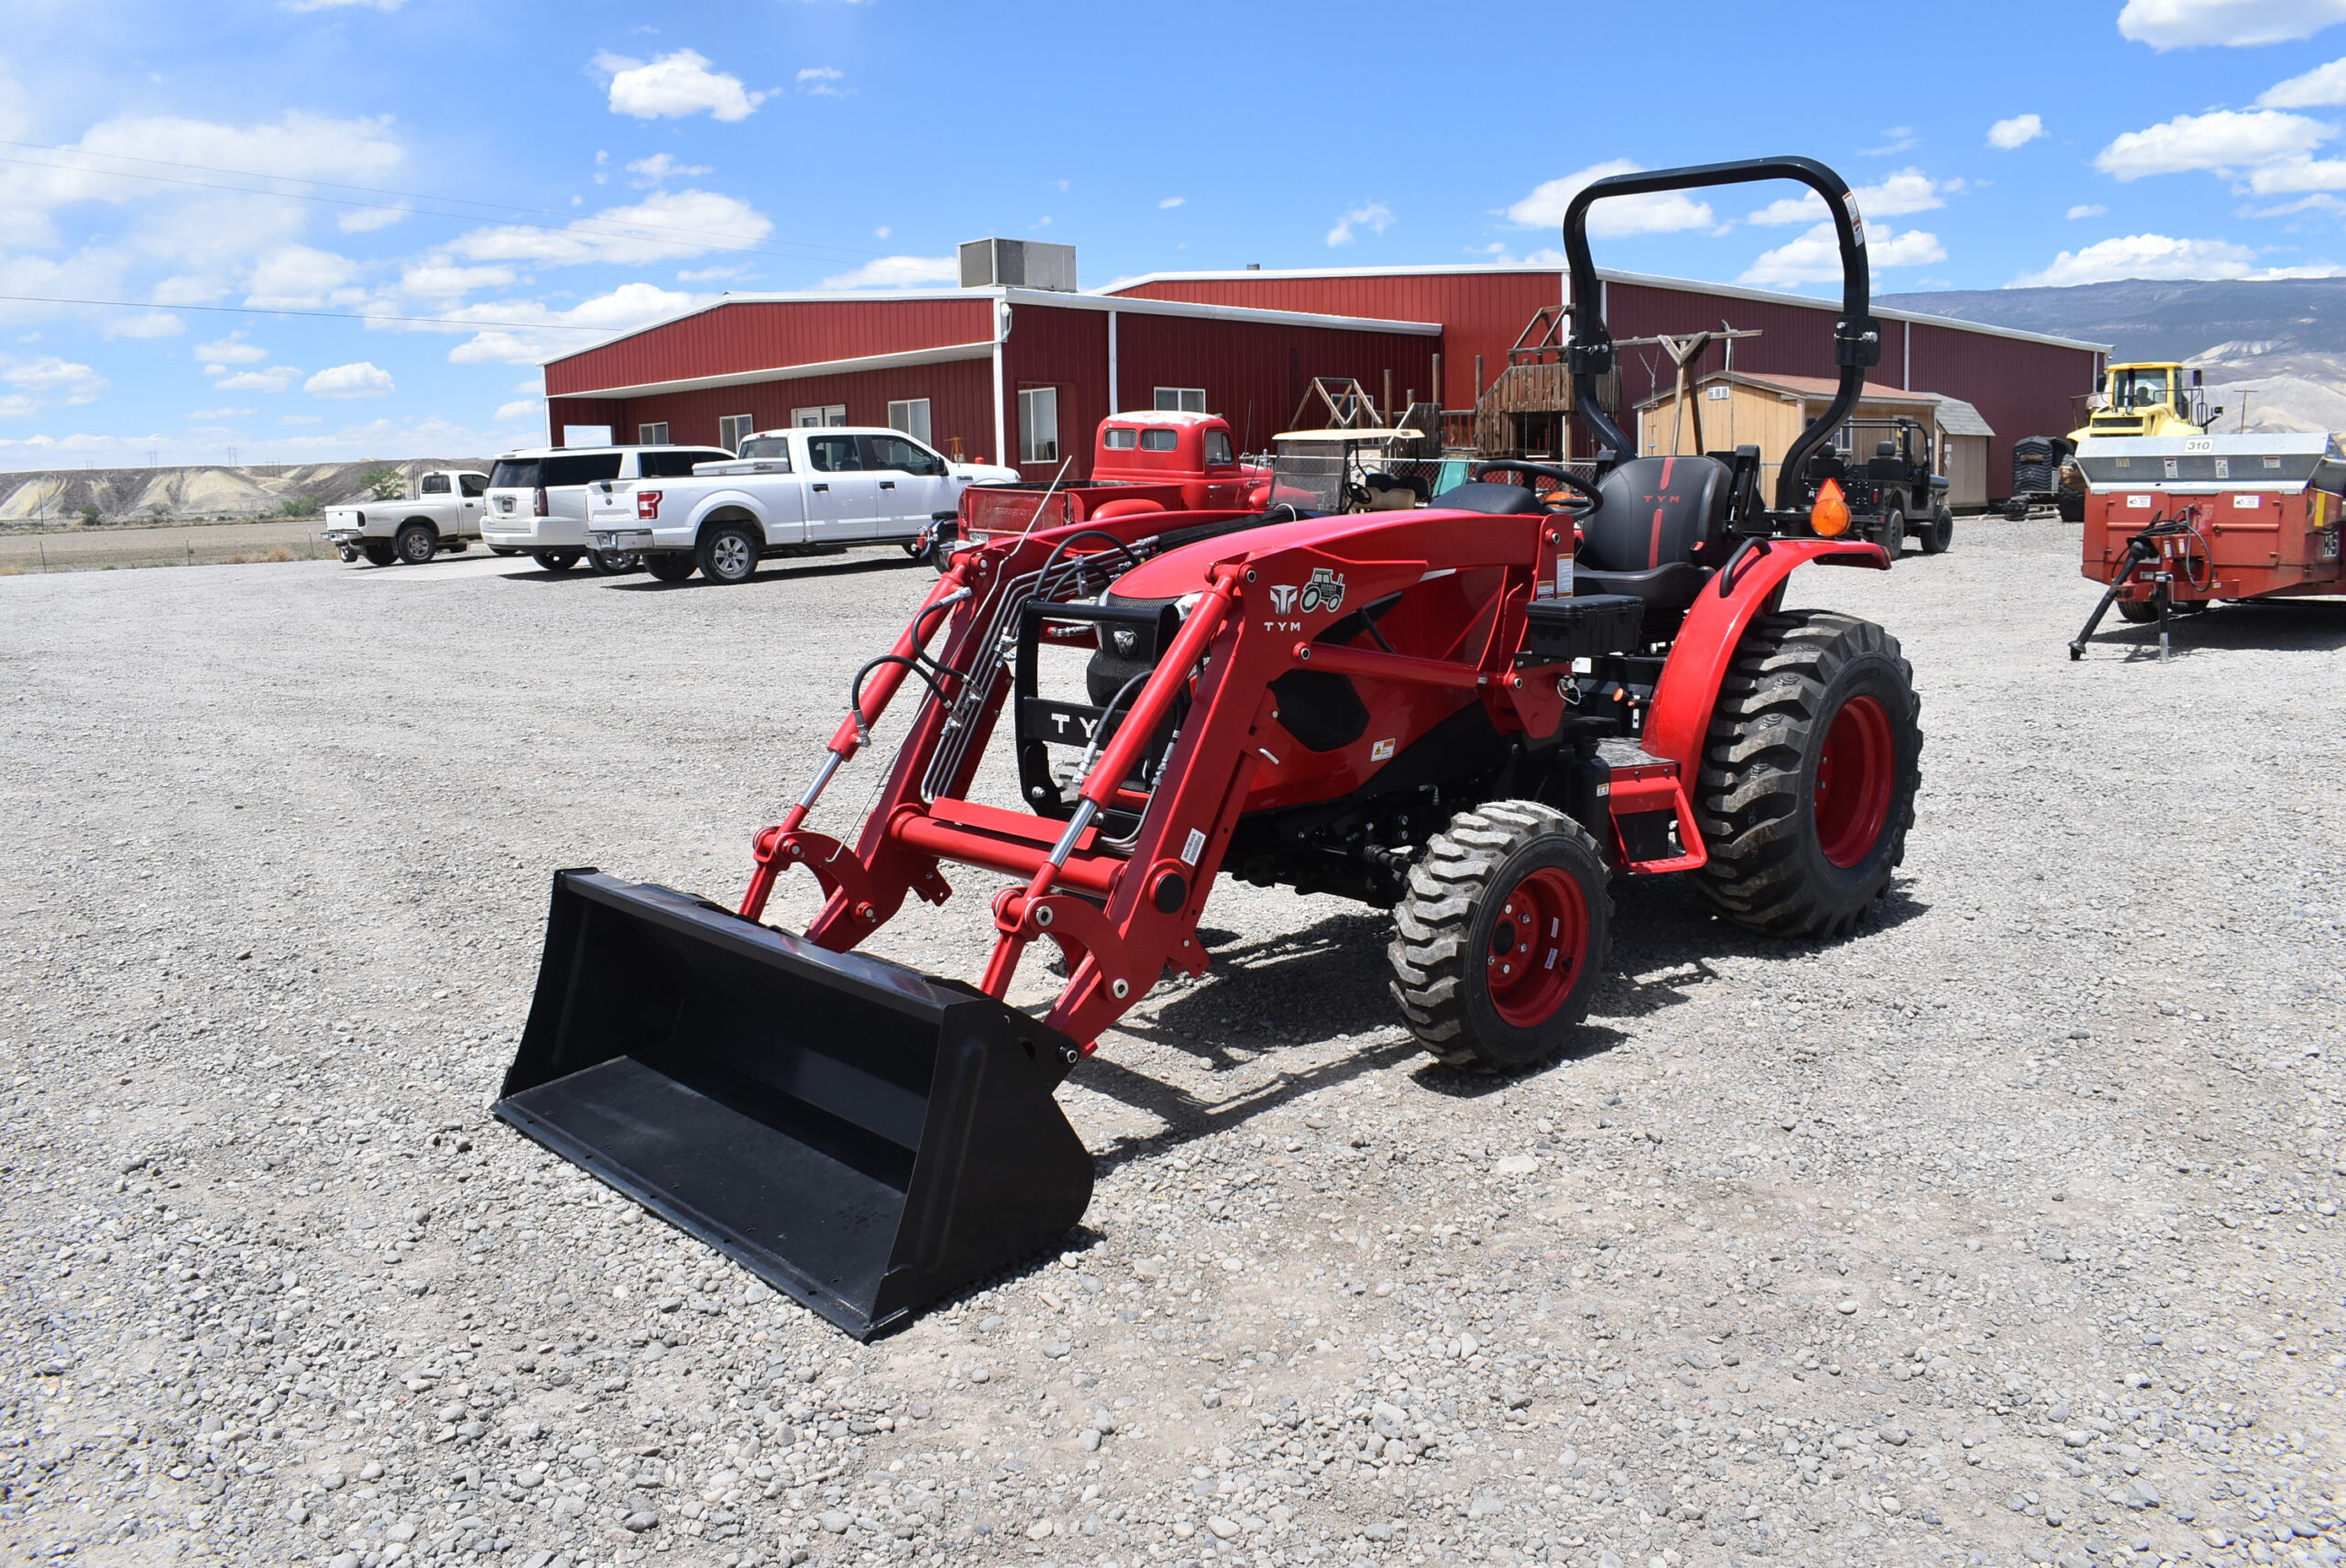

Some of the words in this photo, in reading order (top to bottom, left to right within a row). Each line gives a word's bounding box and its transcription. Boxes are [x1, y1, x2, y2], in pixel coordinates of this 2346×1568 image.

[2187, 441, 2210, 450] 310
[1643, 495, 1681, 503] TYM
[1264, 621, 1301, 631] TYM
[1050, 712, 1099, 739] TY
